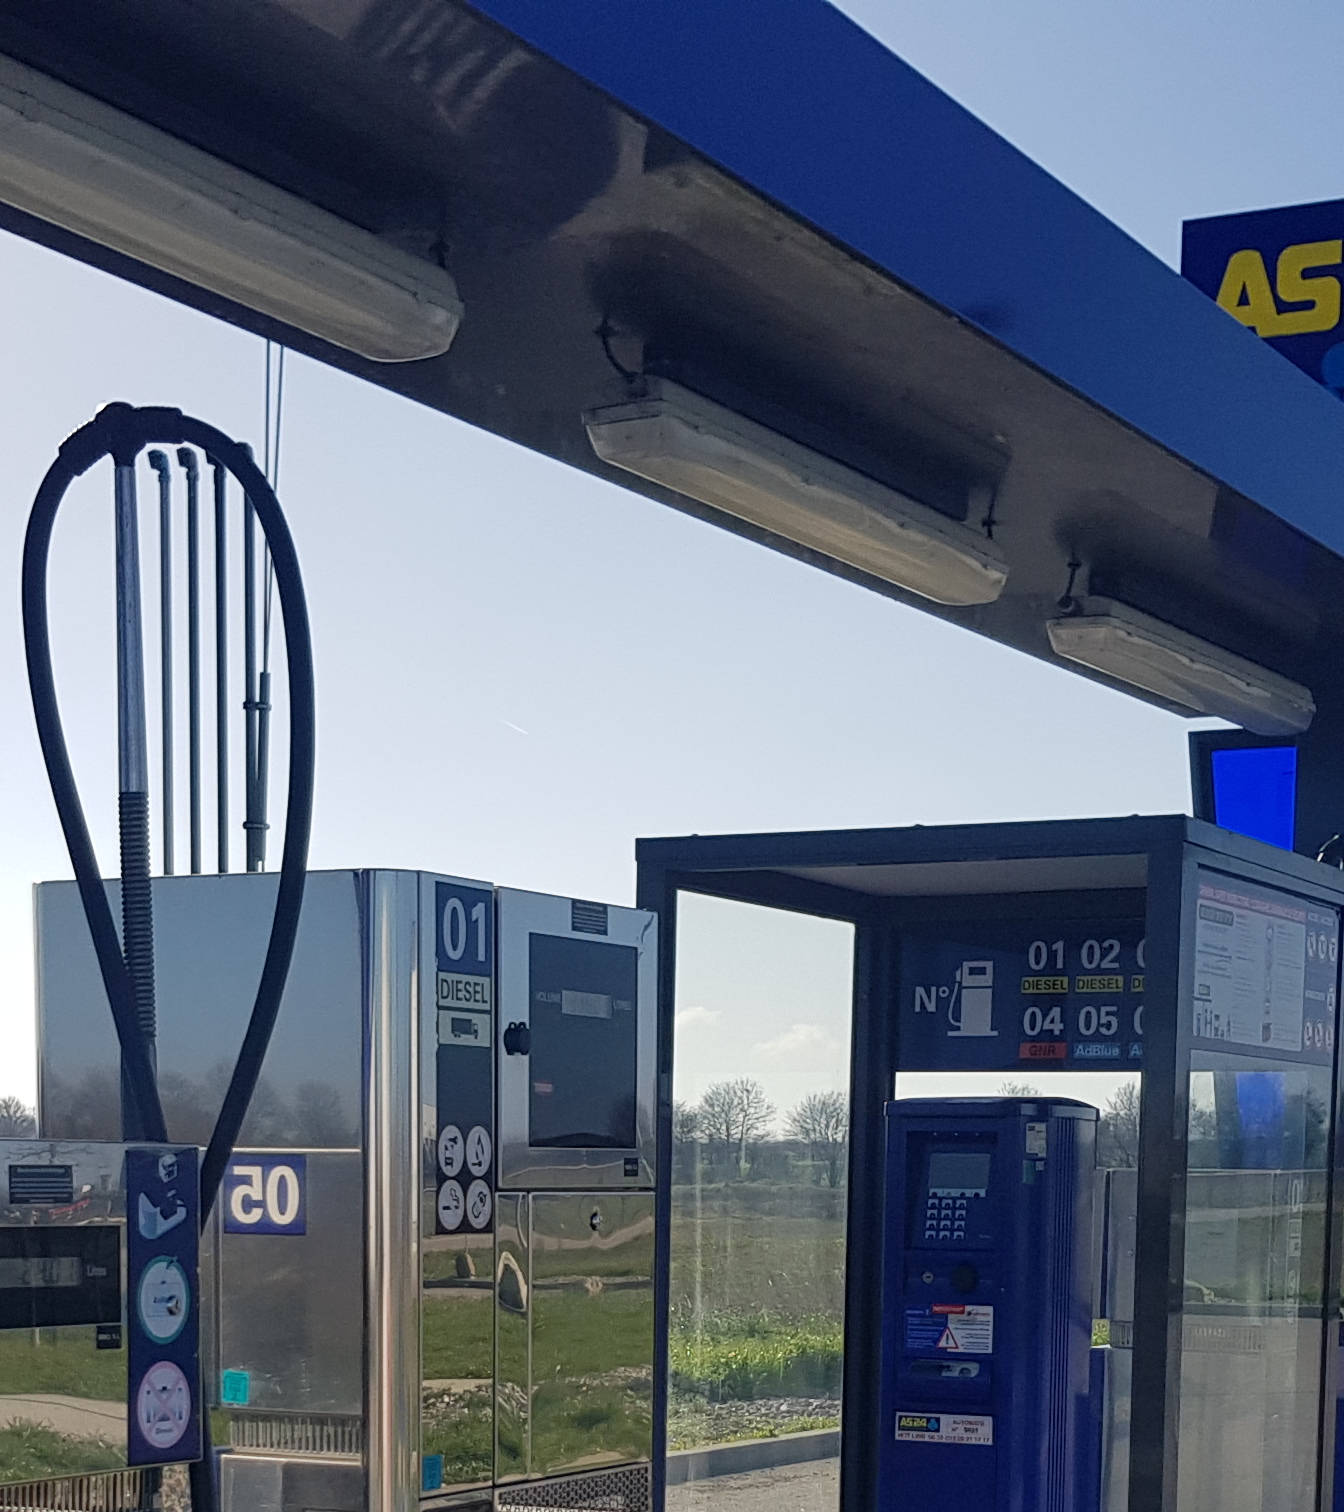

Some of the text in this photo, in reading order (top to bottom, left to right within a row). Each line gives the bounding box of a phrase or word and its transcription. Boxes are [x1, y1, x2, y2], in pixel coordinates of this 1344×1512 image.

[443, 897, 487, 963] 01
[1028, 940, 1065, 970] 01
[1081, 938, 1121, 969] 02
[440, 977, 490, 1005] DIESEL
[1022, 978, 1067, 991] DIESEL
[1077, 977, 1122, 990] DIESEL
[1023, 1006, 1065, 1036] 04
[1078, 1005, 1118, 1036] 05
[1028, 1044, 1057, 1057] GNR
[1076, 1044, 1121, 1056] AdBlue
